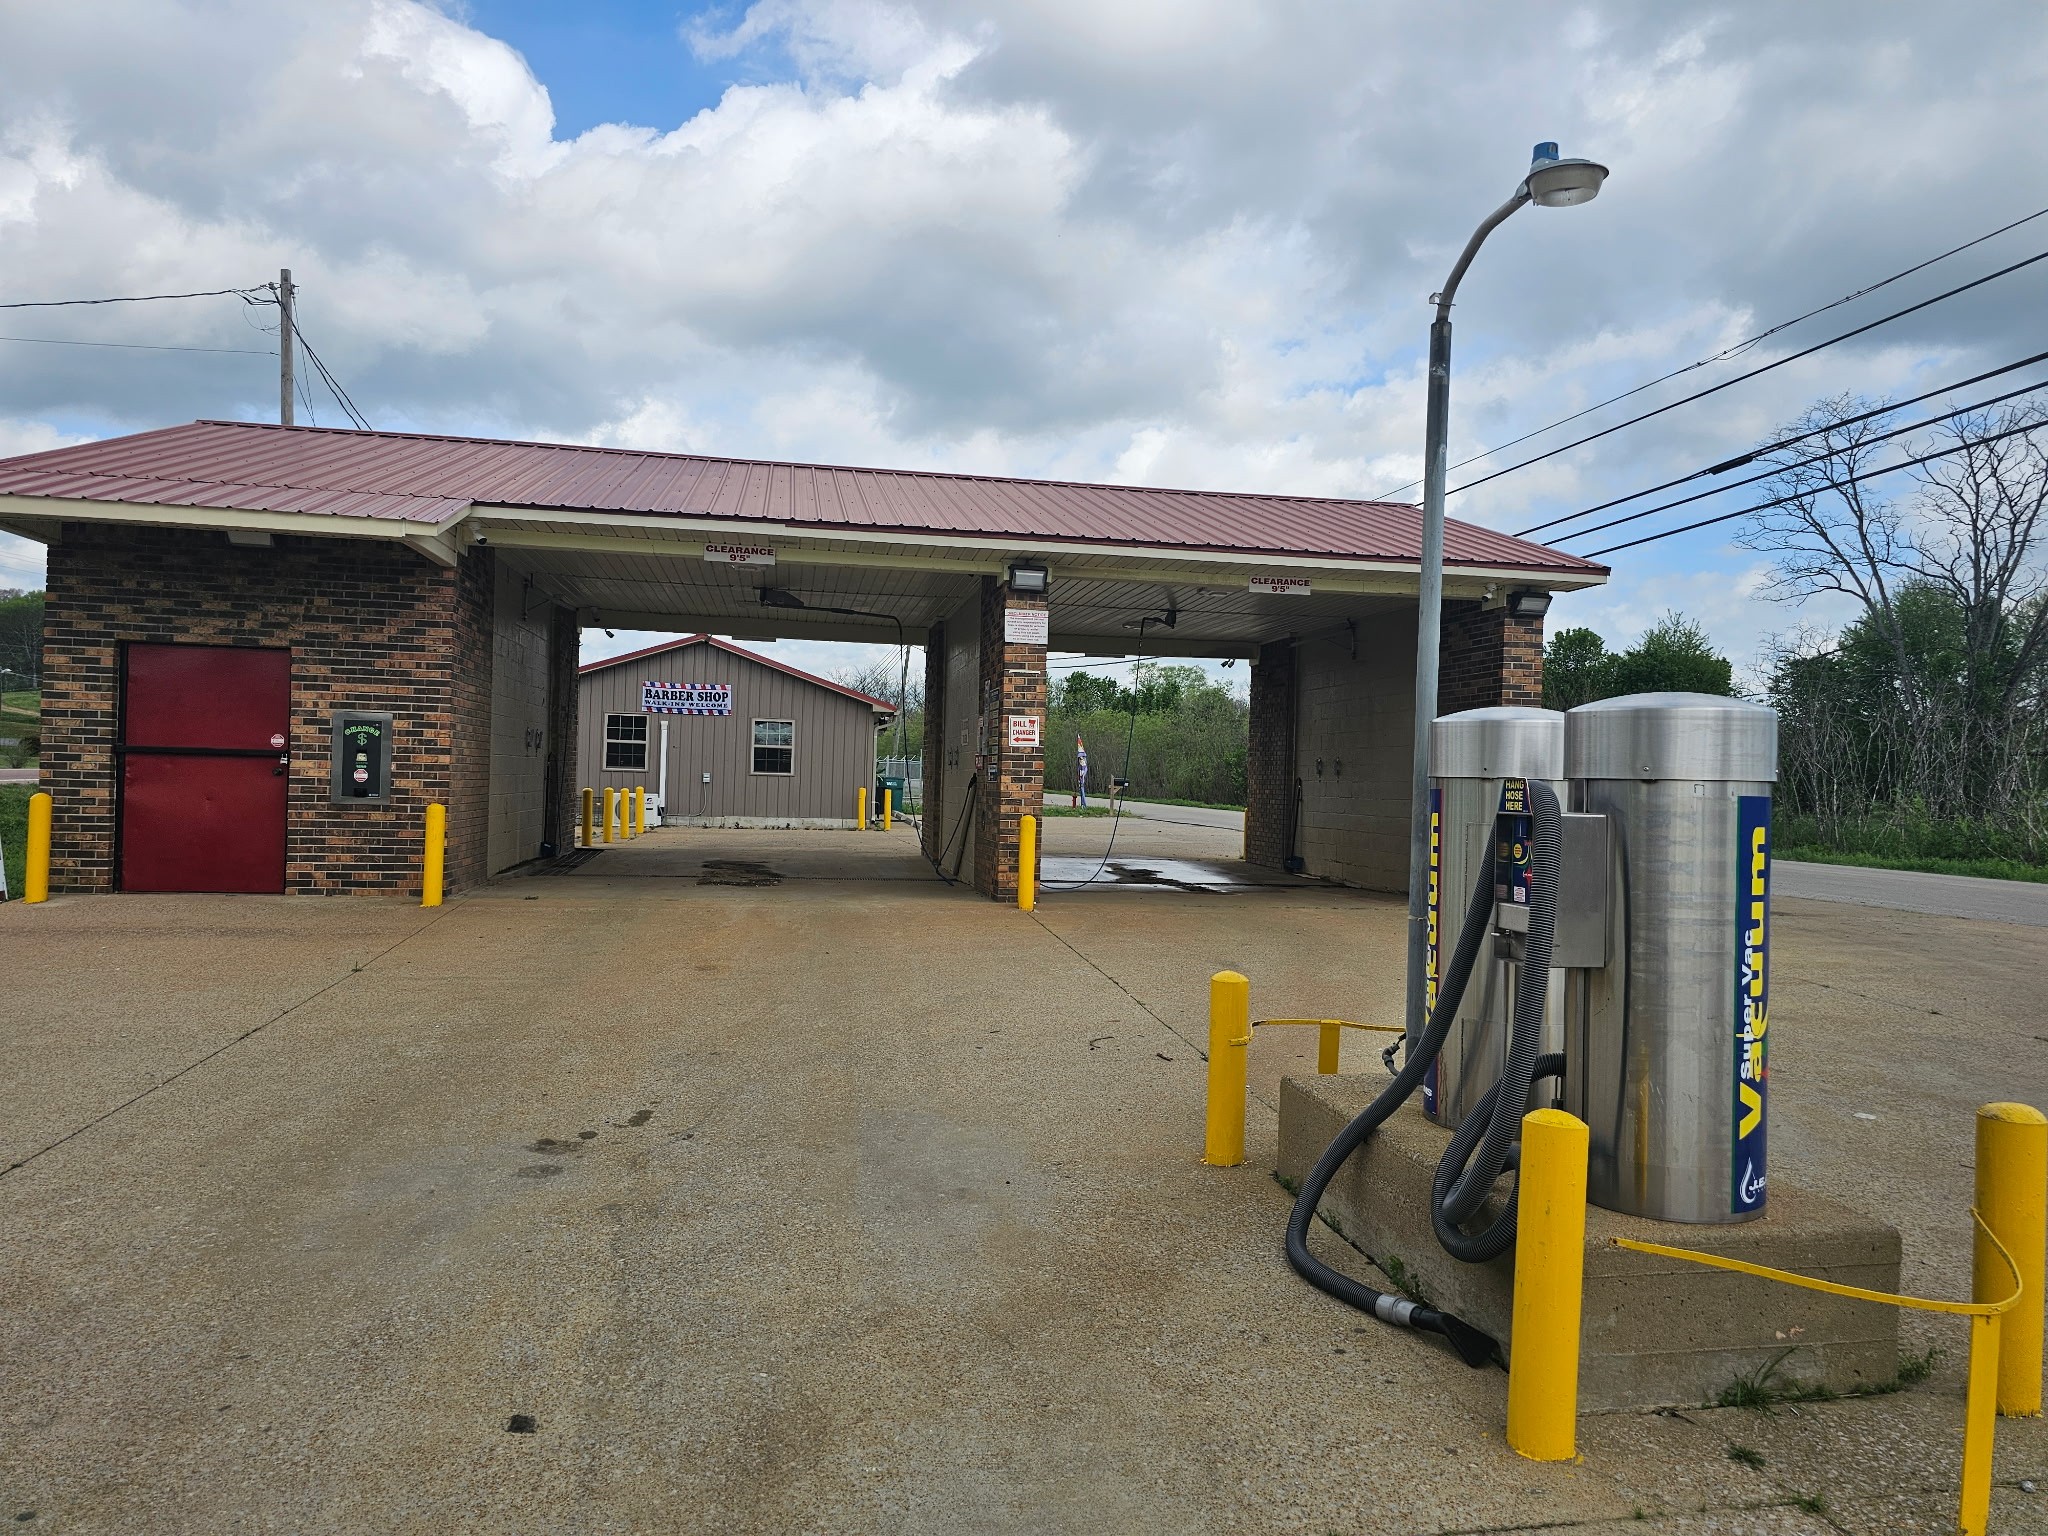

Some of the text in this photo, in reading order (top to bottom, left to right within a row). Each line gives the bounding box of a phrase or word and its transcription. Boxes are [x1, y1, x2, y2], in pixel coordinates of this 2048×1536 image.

[706, 545, 774, 556] CLEARANCE
[729, 554, 751, 562] 9'5"
[1251, 578, 1310, 586] CLEARANCE
[645, 688, 729, 703] BARBER SHOP
[344, 725, 381, 737] CHANGE
[1505, 780, 1524, 789] HANG
[1505, 790, 1524, 801] HOSE
[1505, 801, 1523, 811] HERE
[1736, 826, 1767, 1140] Vacuum
[1740, 929, 1754, 1080] Super Vac
